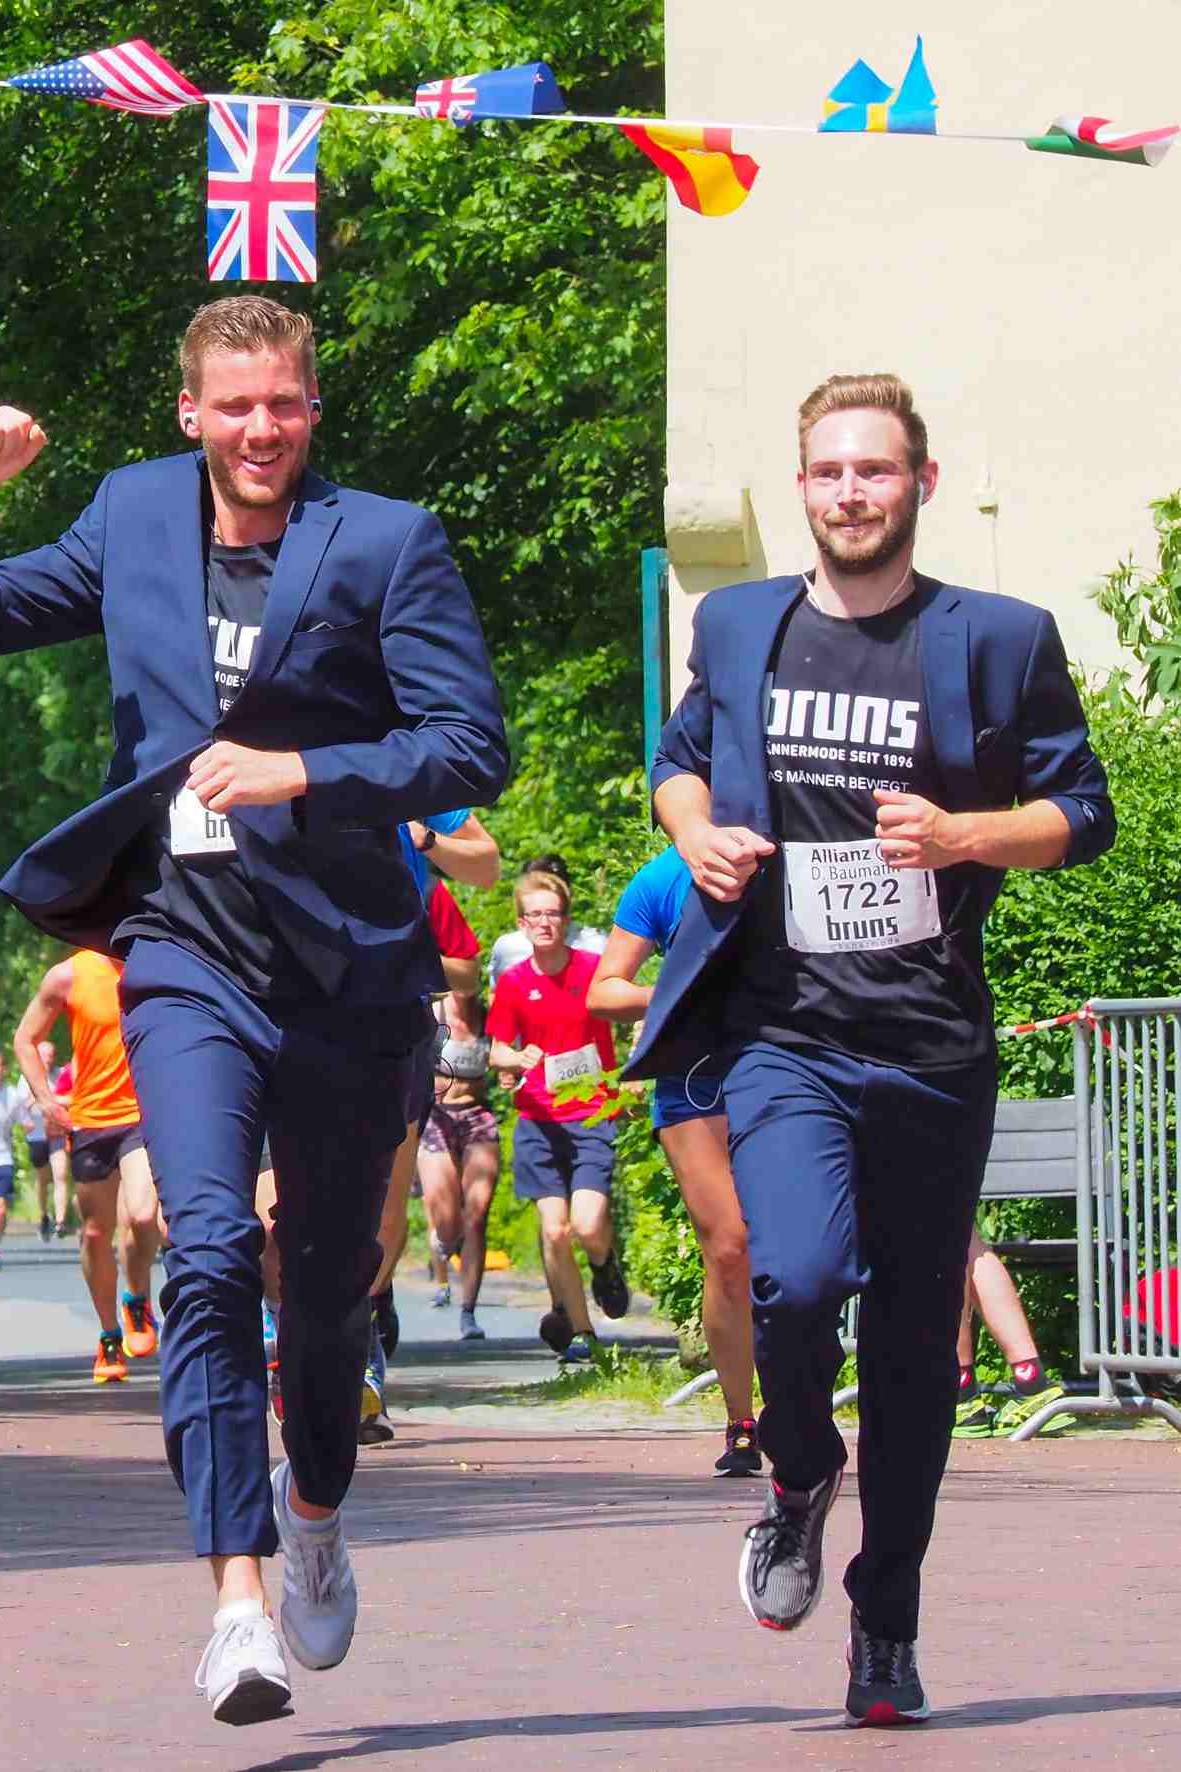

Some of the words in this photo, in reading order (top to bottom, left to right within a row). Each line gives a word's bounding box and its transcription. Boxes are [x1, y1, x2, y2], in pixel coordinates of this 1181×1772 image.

[849, 750, 880, 765] SEIT
[883, 754, 914, 768] 1896
[811, 848, 870, 864] Allianz
[818, 879, 901, 911] 1722
[826, 914, 898, 941] bruns
